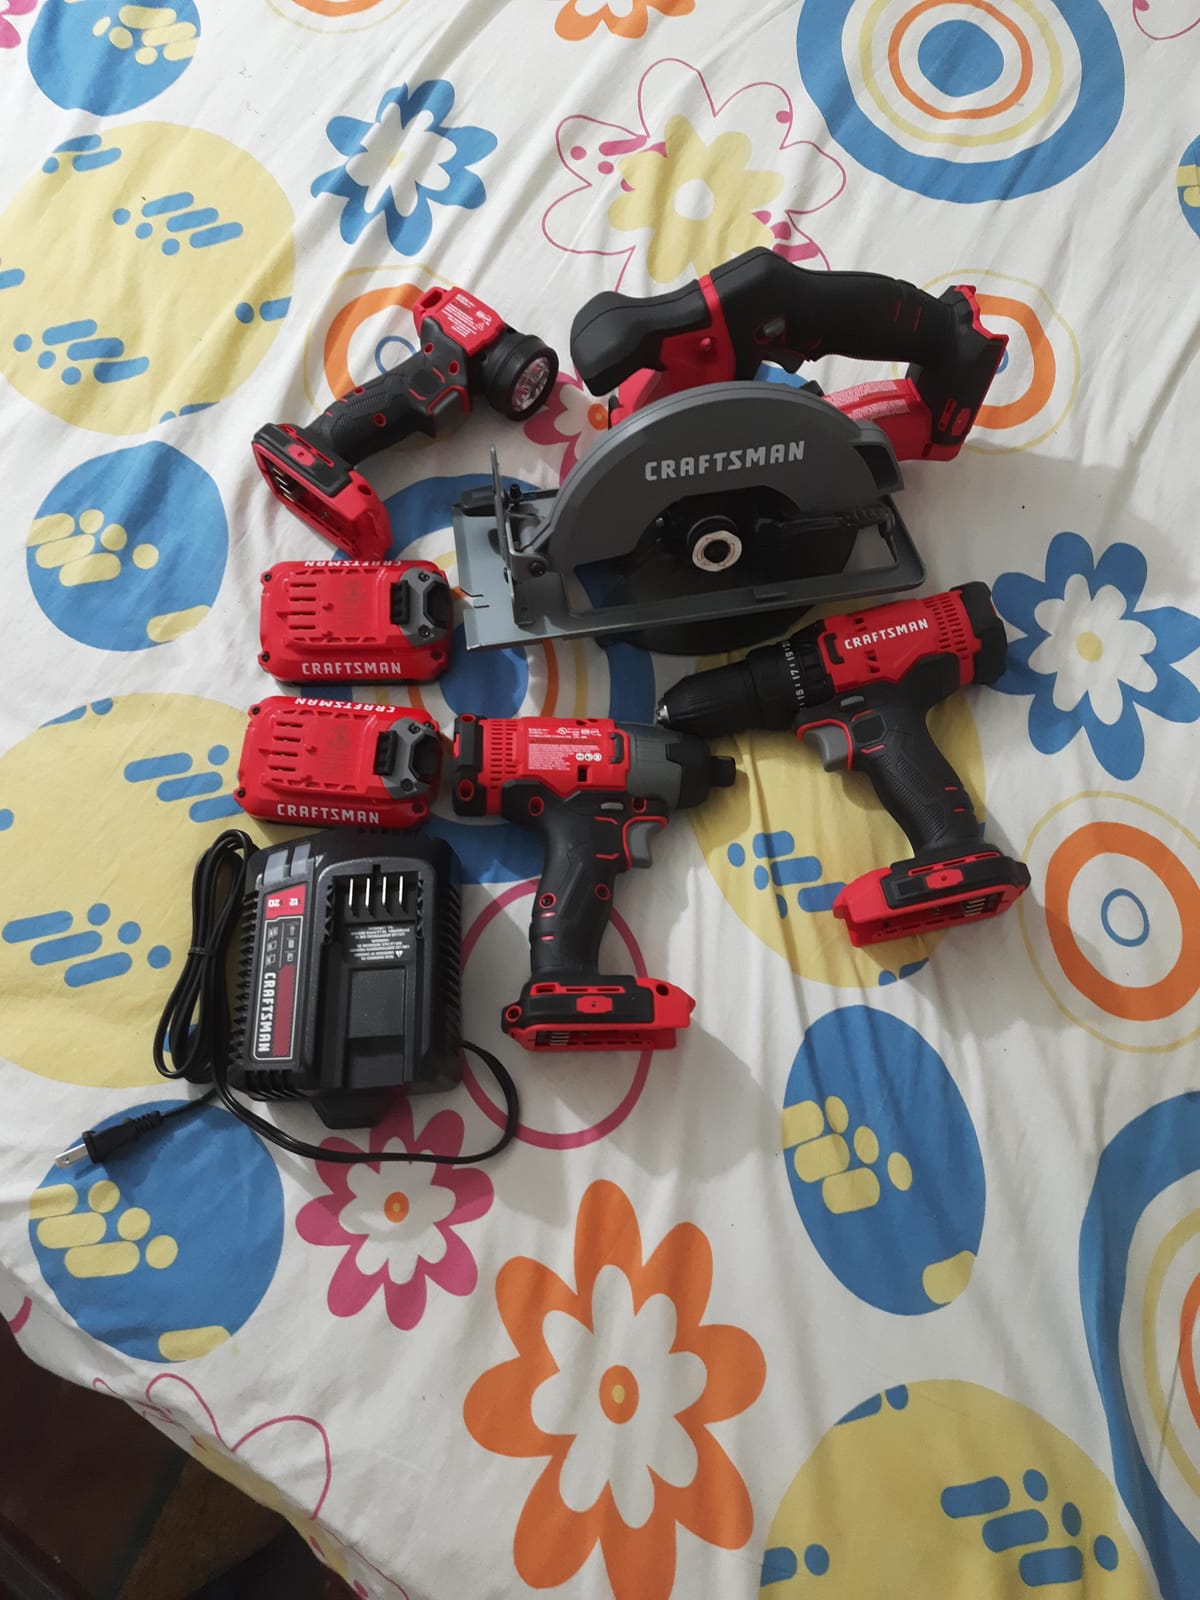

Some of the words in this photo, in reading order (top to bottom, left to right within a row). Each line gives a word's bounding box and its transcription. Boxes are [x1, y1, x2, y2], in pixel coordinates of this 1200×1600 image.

[645, 440, 805, 481] CRAFTSMAN
[844, 618, 929, 650] CRAFTSMAN
[301, 661, 402, 676] CRAFTSMAN
[294, 697, 396, 714] CRAFTSMAN
[277, 803, 380, 825] CRAFTSMAN
[257, 971, 276, 1052] CRAFTSMAN
